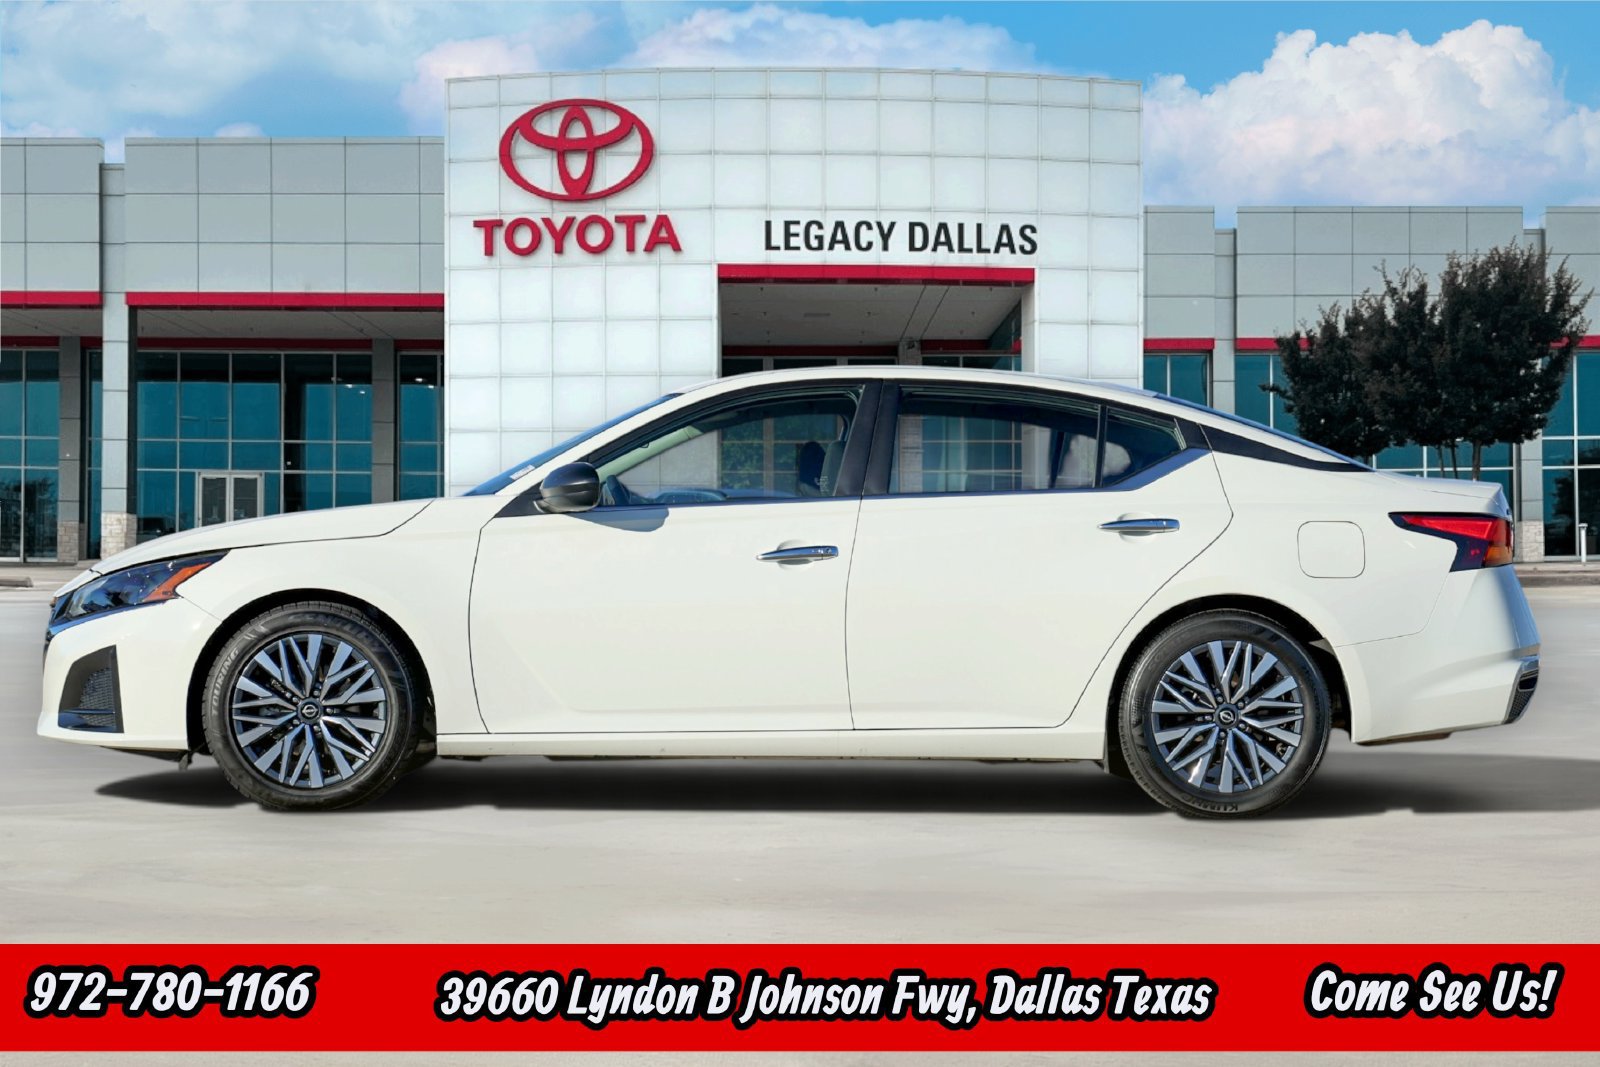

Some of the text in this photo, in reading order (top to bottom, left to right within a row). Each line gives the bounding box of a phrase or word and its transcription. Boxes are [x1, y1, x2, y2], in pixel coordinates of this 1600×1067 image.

[473, 213, 682, 256] TOYOTA
[764, 220, 1038, 255] LEGACY DALLAS
[211, 647, 239, 717] TOURING
[1181, 792, 1239, 812] KUMHO
